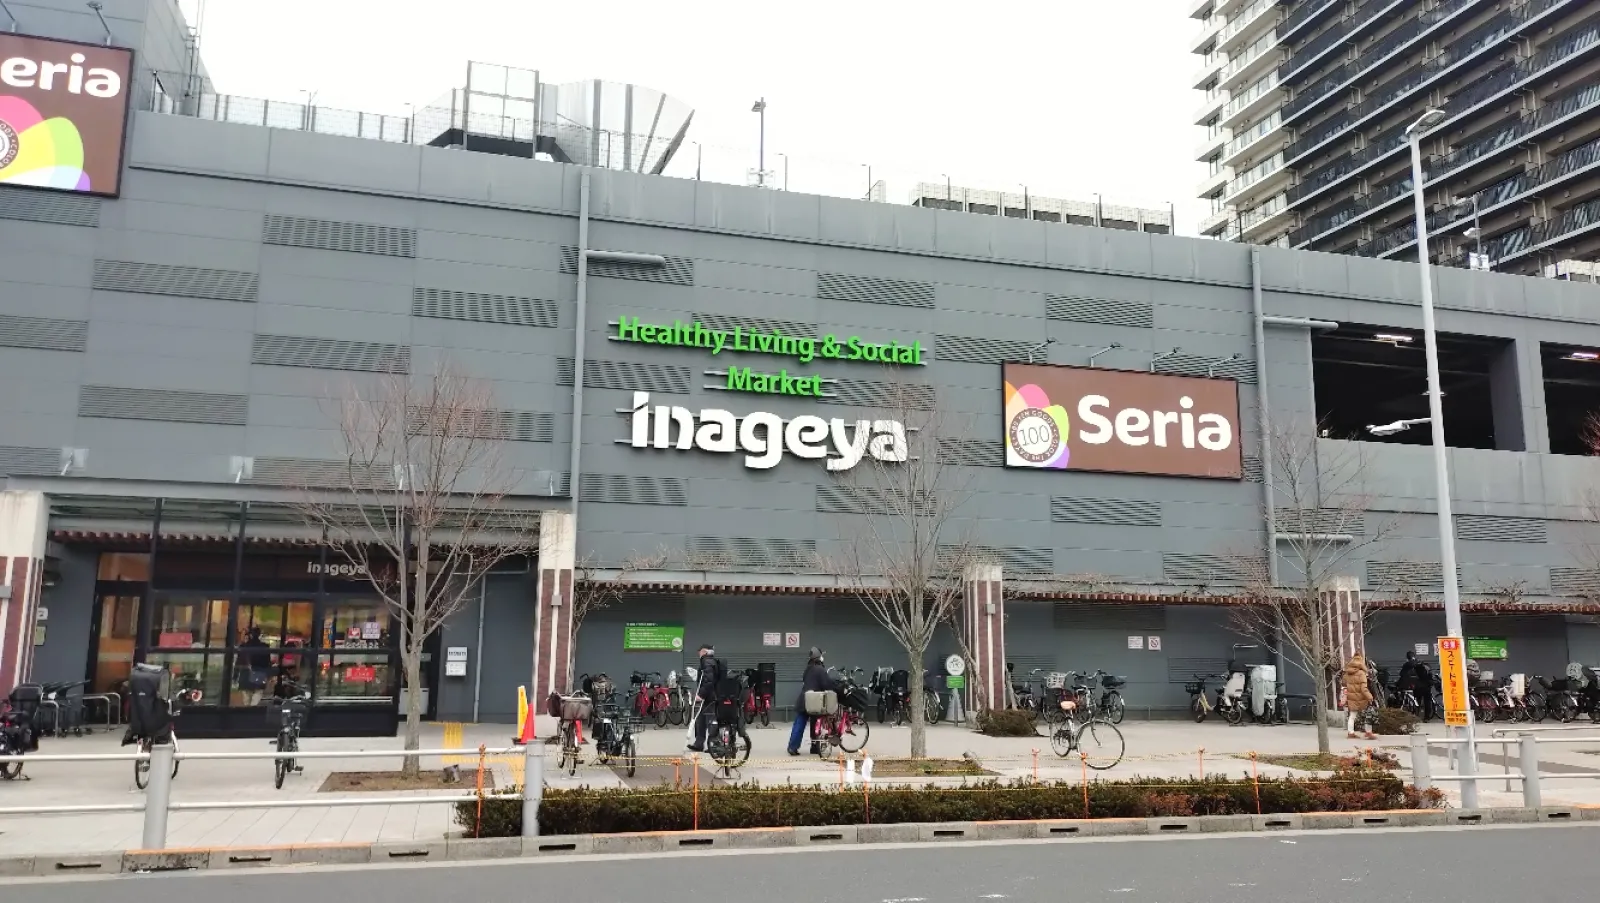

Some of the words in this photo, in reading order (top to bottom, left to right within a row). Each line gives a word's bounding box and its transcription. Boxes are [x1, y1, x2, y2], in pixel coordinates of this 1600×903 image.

[1, 53, 120, 97] eria
[618, 315, 728, 355] Healthy
[733, 326, 815, 363] Living
[819, 333, 842, 359] &
[846, 336, 921, 365] Social
[727, 365, 823, 397] Market
[631, 391, 908, 471] inageya
[1019, 424, 1049, 446] 100
[1078, 395, 1232, 451] Seria
[307, 561, 366, 576] inageya
